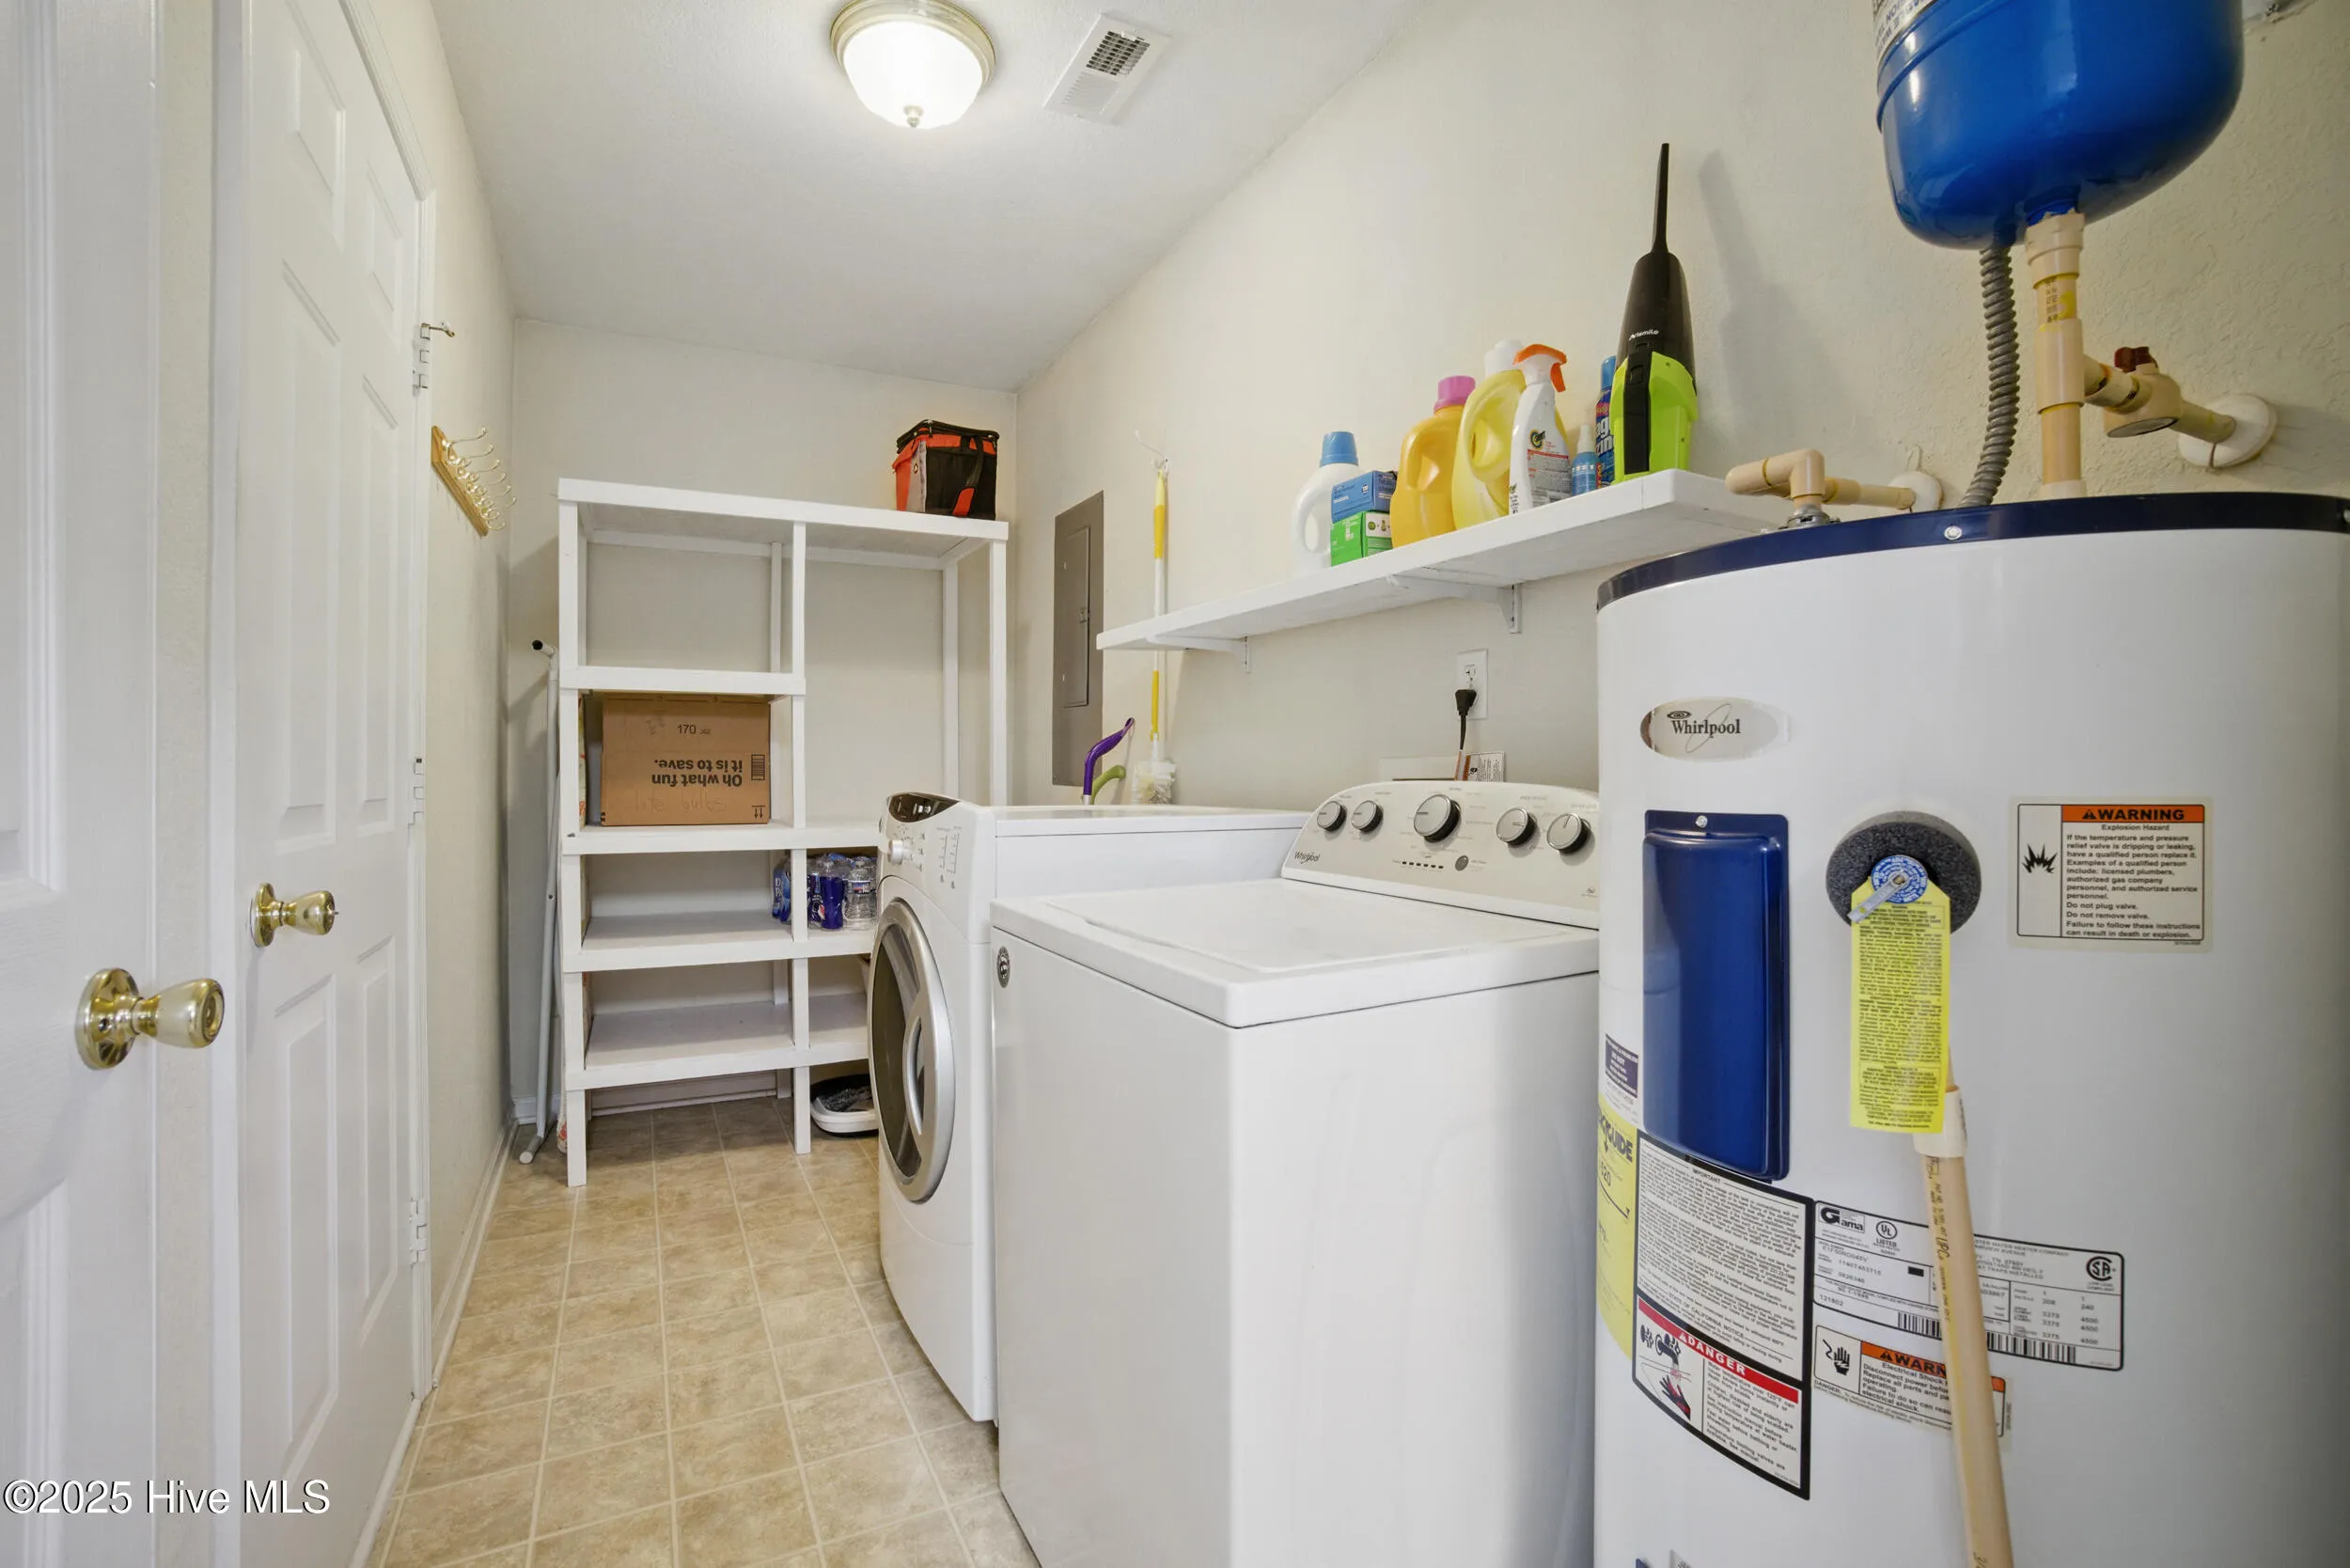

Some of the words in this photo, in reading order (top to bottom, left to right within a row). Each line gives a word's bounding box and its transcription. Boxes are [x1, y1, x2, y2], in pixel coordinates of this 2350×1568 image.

[678, 724, 697, 734] 170
[1670, 719, 1742, 738] Whirlpool
[654, 760, 694, 770] save.
[697, 760, 713, 772] to
[715, 760, 728, 773] is
[730, 760, 743, 773] it
[651, 774, 678, 787] fun
[681, 774, 719, 787] what
[722, 774, 743, 787] Oh
[2097, 808, 2185, 821] WARNING
[1687, 1334, 1745, 1376] DANGER
[1894, 1352, 1946, 1377] WARN
[1934, 1404, 1951, 1416] resu
